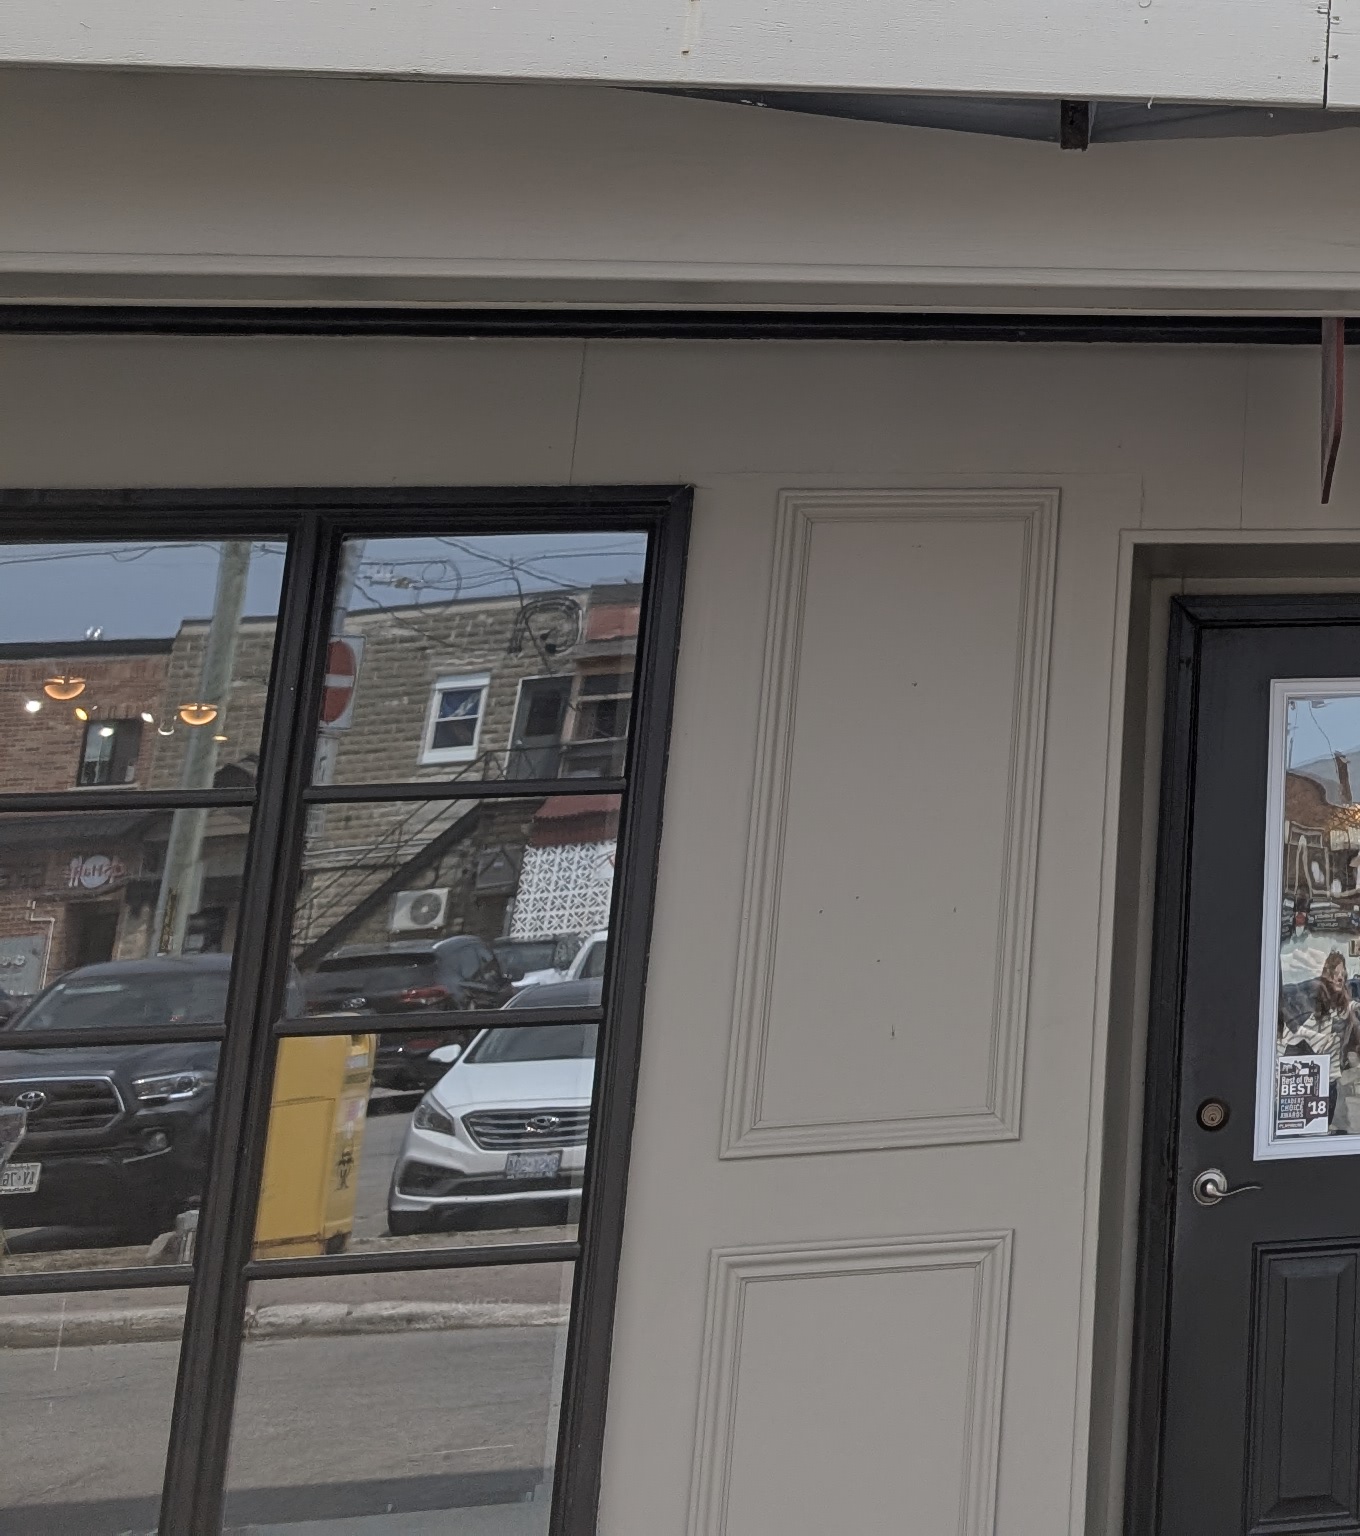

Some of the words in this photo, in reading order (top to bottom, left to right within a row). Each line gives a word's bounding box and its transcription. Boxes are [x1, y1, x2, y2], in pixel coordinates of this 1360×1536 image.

[1281, 1075, 1295, 1085] Best
[1296, 1075, 1303, 1084] of
[1281, 1083, 1313, 1096] BEST
[1280, 1104, 1304, 1112] CHOICE
